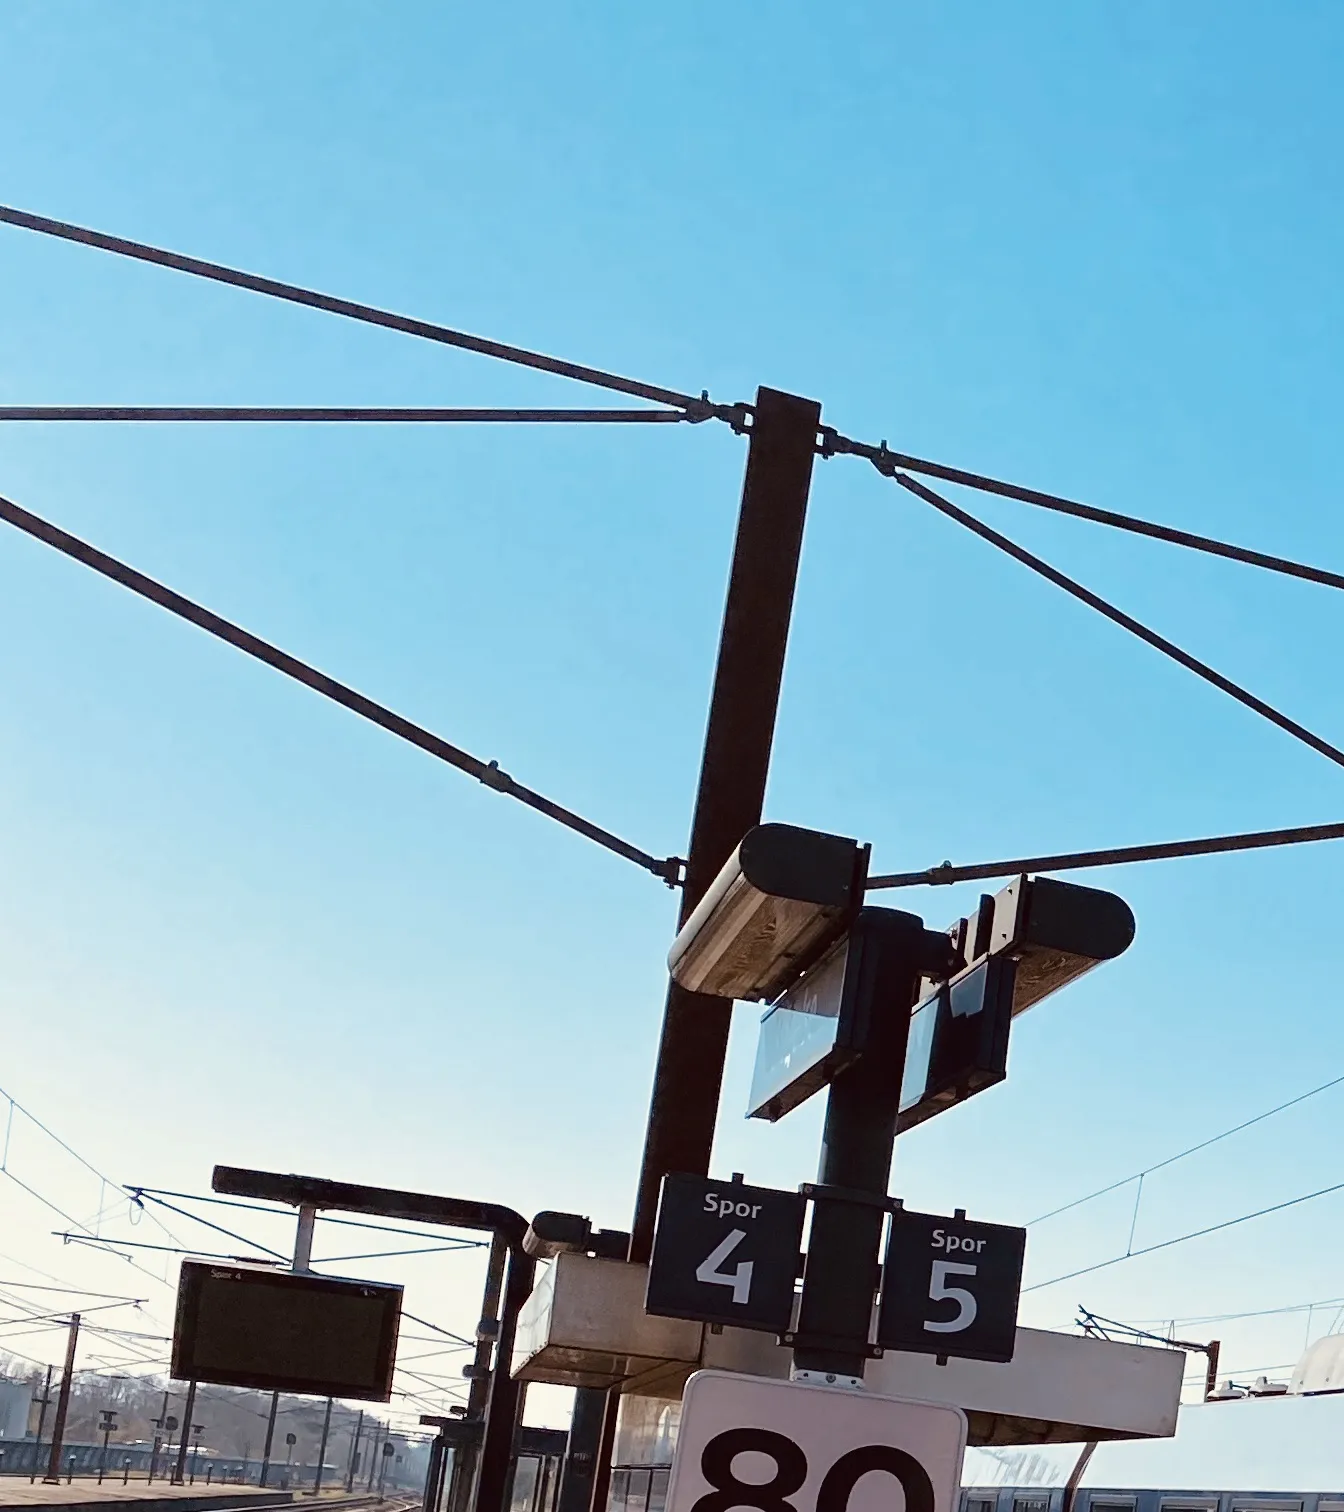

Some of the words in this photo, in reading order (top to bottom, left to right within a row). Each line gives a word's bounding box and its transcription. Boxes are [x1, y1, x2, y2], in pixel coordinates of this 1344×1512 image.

[703, 1193, 762, 1219] Spor
[695, 1228, 754, 1305] 4
[930, 1229, 987, 1255] Spor
[923, 1260, 977, 1334] 5
